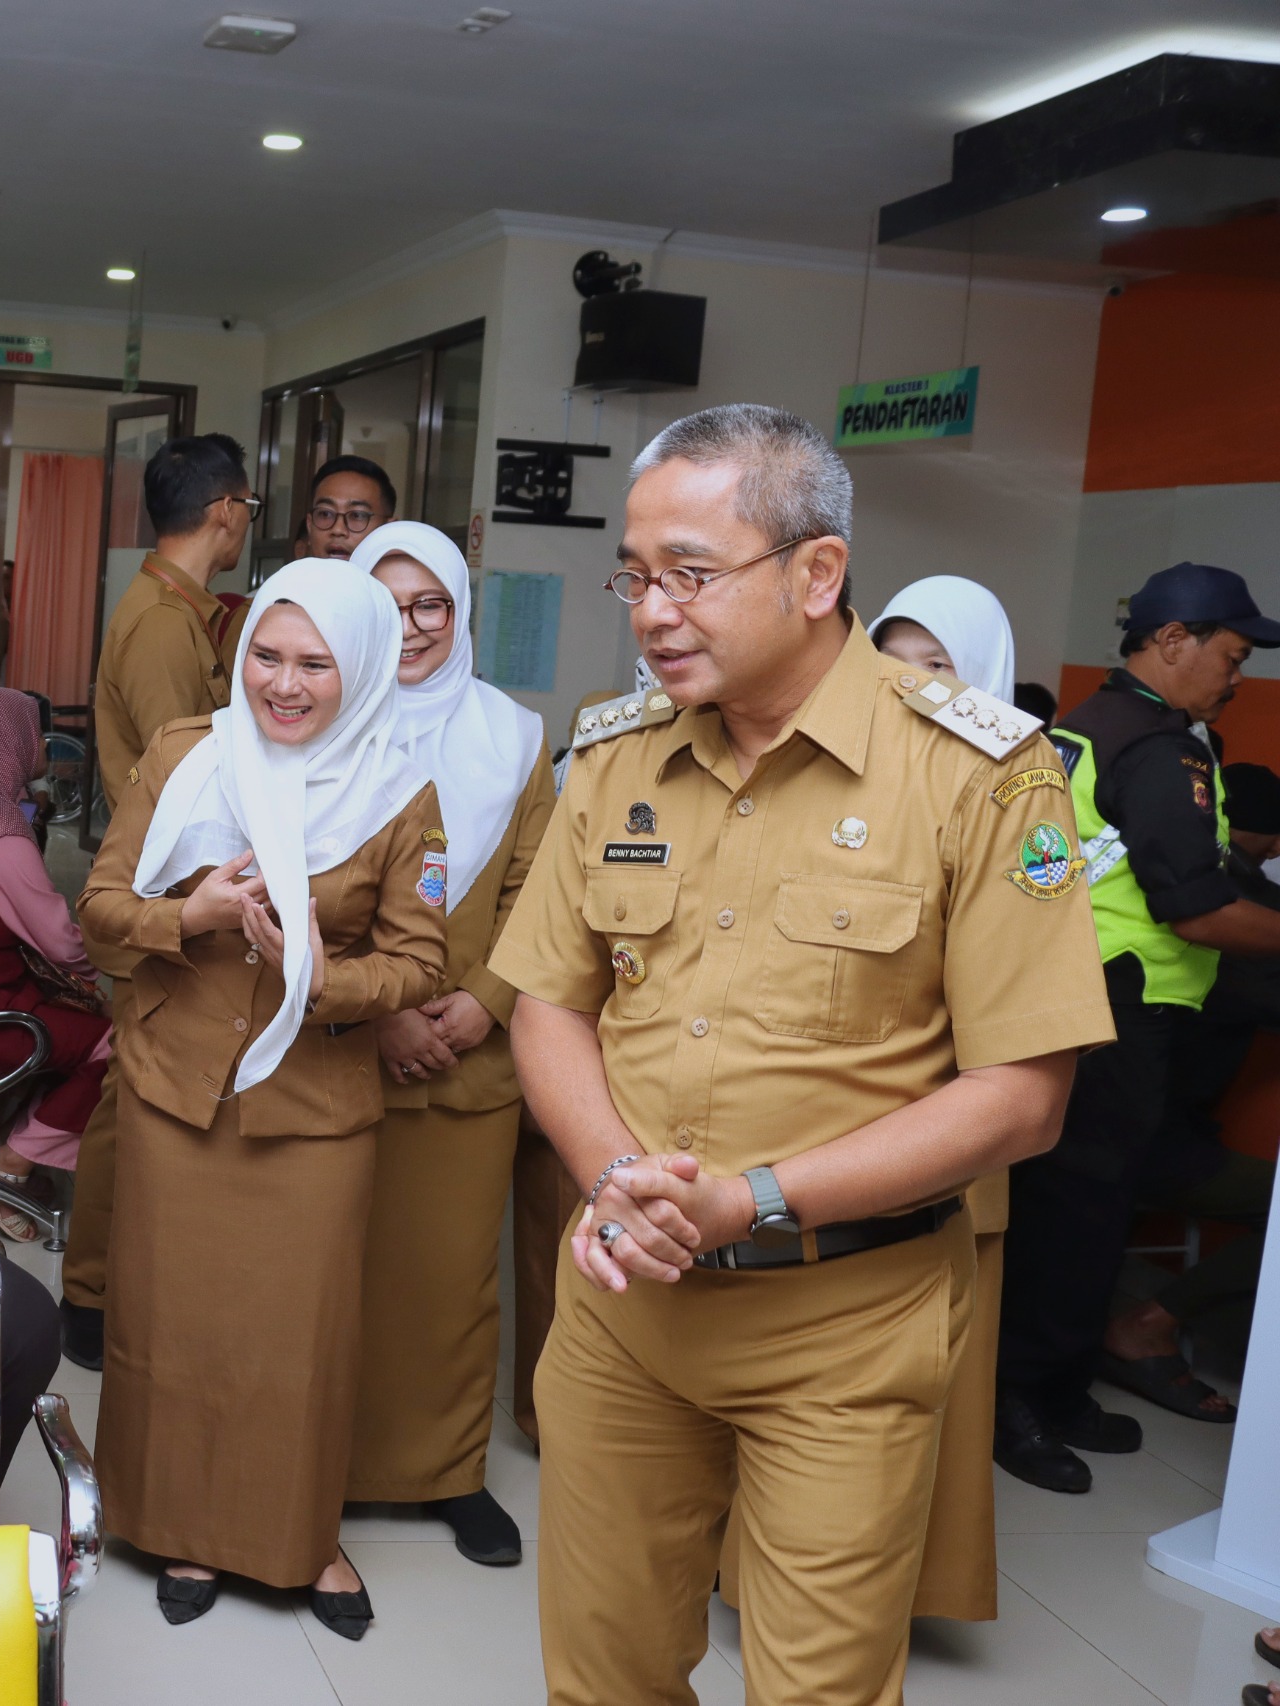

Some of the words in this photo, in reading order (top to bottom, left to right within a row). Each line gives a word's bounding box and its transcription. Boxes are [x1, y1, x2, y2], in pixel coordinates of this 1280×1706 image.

[6, 350, 34, 364] UGD
[884, 381, 923, 395] KLASTER
[841, 390, 969, 435] PENDAFTARAN
[996, 776, 1027, 801] PROVINSI
[1027, 770, 1046, 785] JAWA
[608, 848, 629, 857] BENNY
[630, 849, 661, 858] BACHTIAR
